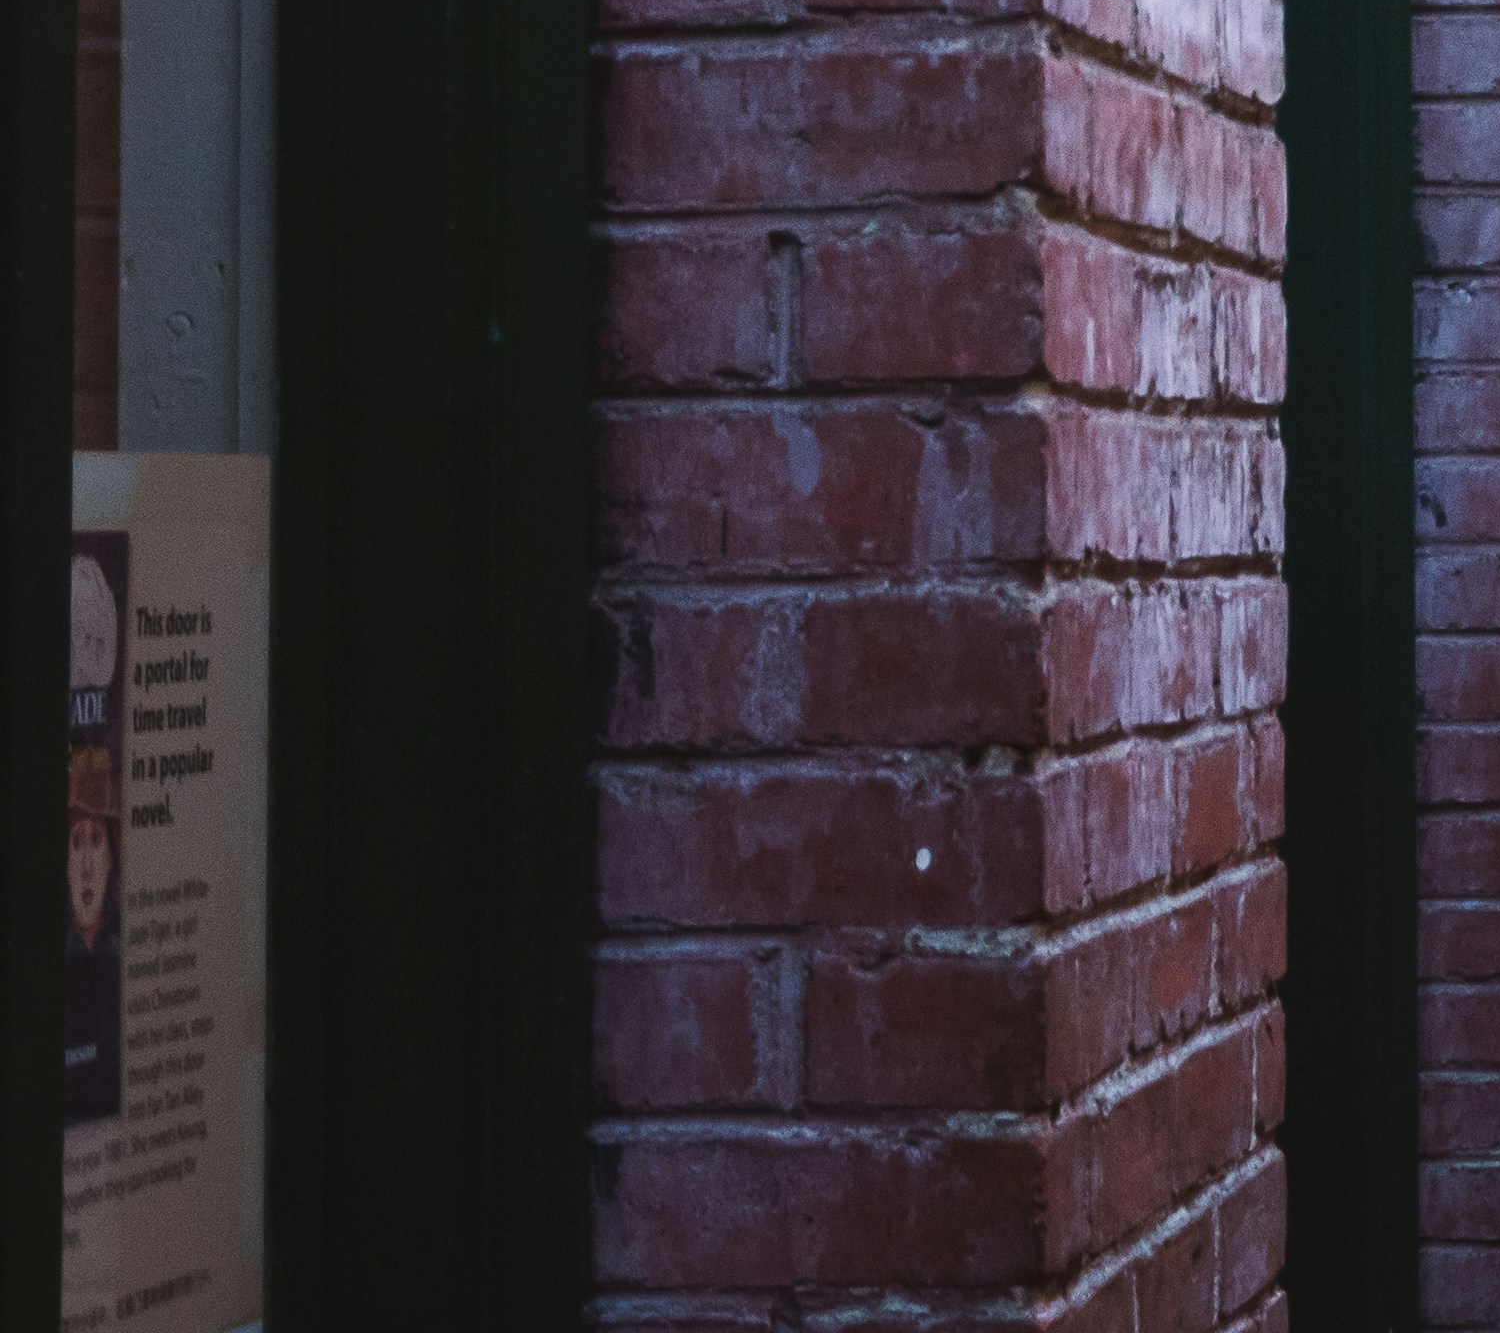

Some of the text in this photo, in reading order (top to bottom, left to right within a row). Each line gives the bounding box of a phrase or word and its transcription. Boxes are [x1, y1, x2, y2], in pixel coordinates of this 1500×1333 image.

[136, 603, 212, 636] This door is
[134, 650, 209, 693] a portal for
[72, 691, 106, 725] ADE
[133, 695, 207, 734] time travel
[132, 744, 213, 785] in a popular
[131, 793, 174, 828] novel.
